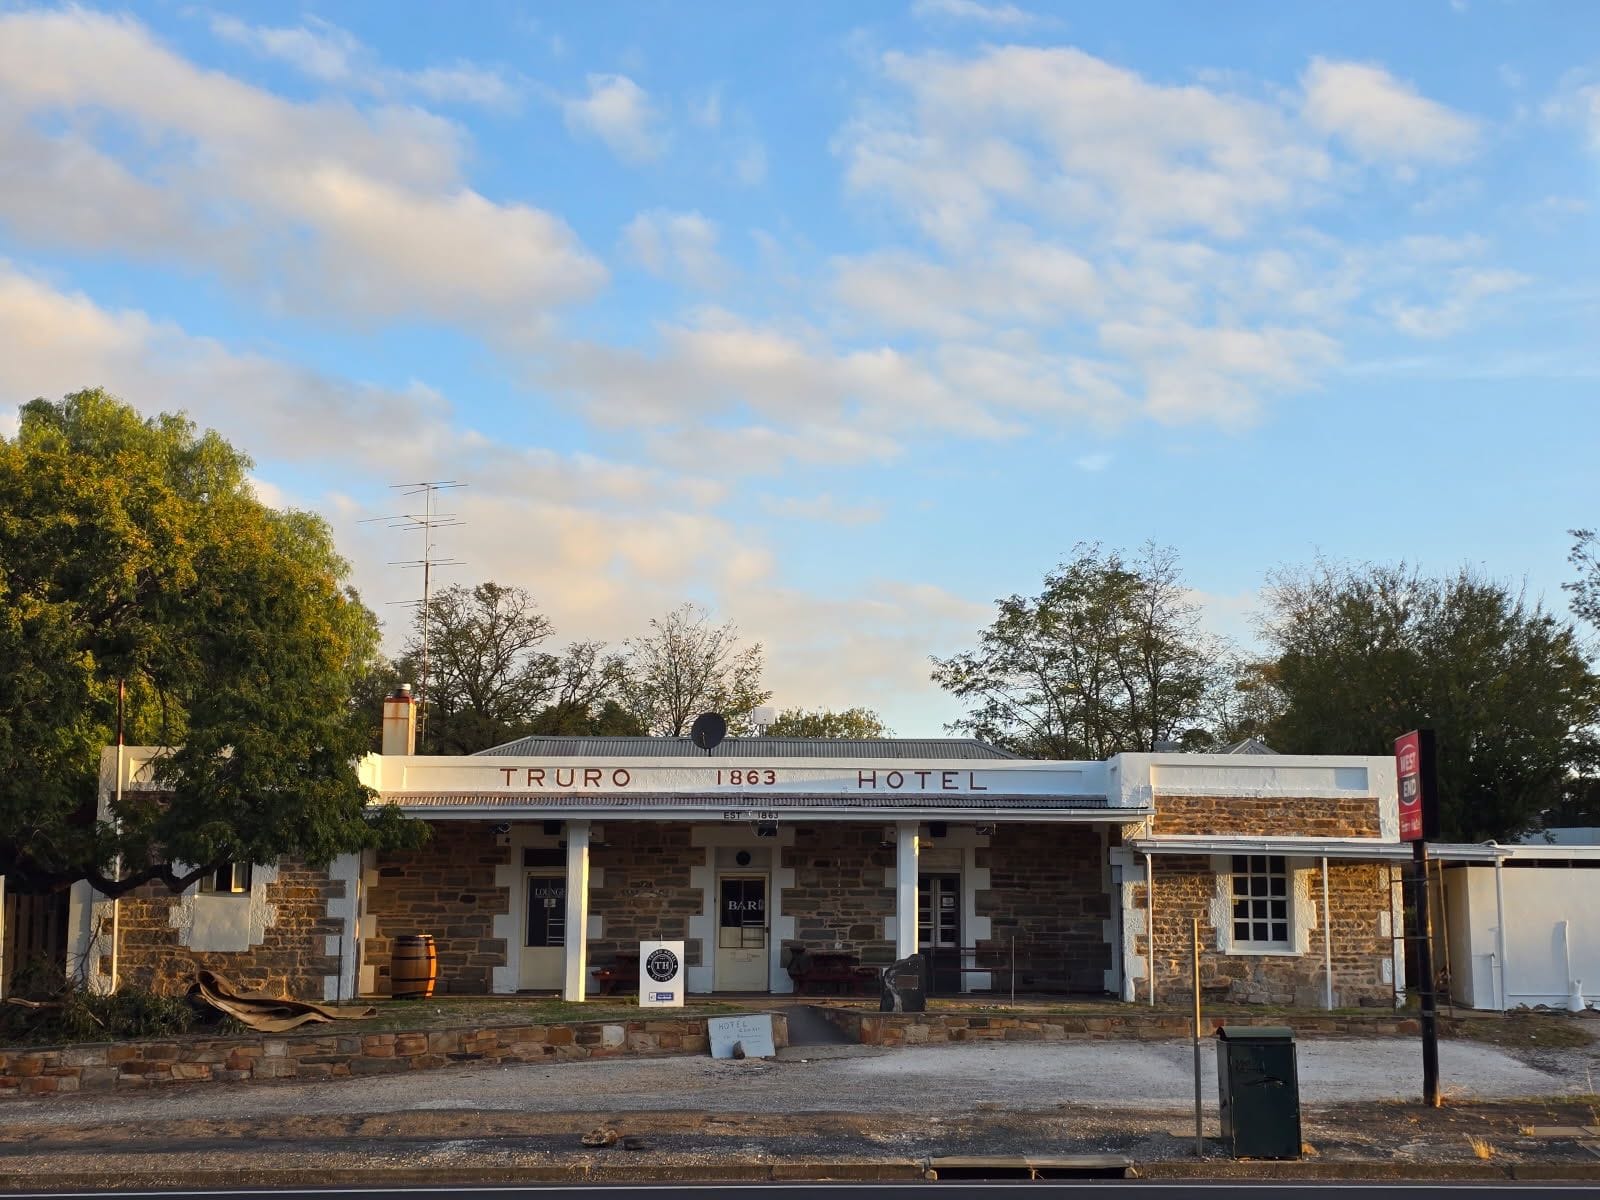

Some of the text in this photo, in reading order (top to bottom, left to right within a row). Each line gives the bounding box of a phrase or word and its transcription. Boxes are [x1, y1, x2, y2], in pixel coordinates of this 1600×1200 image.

[1400, 752, 1417, 773] WEST
[499, 768, 988, 790] TRURO 1863 HOTEL
[1403, 778, 1417, 798] END
[723, 811, 779, 819] EST 1863
[535, 887, 567, 896] LOUNGE
[728, 900, 757, 911] BAR
